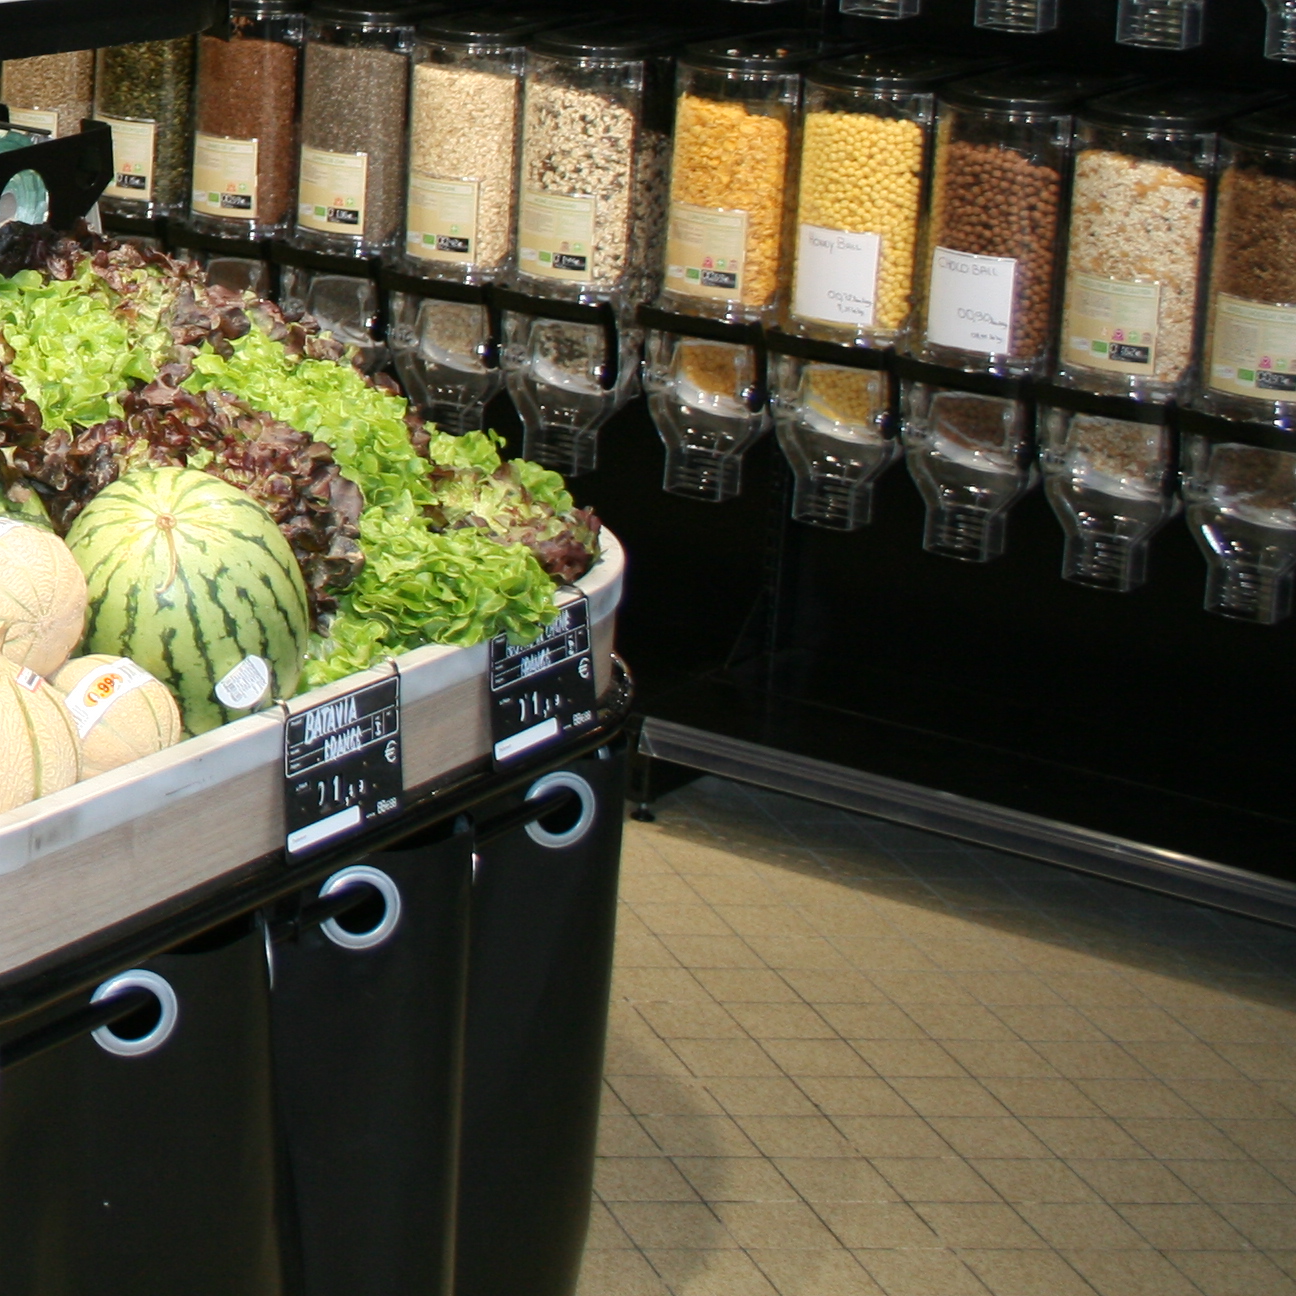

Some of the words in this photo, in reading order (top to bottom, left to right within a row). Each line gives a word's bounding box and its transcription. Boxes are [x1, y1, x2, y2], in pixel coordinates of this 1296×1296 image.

[578, 657, 590, 679] €
[304, 695, 358, 745] BATAVIA
[384, 740, 397, 763] €
